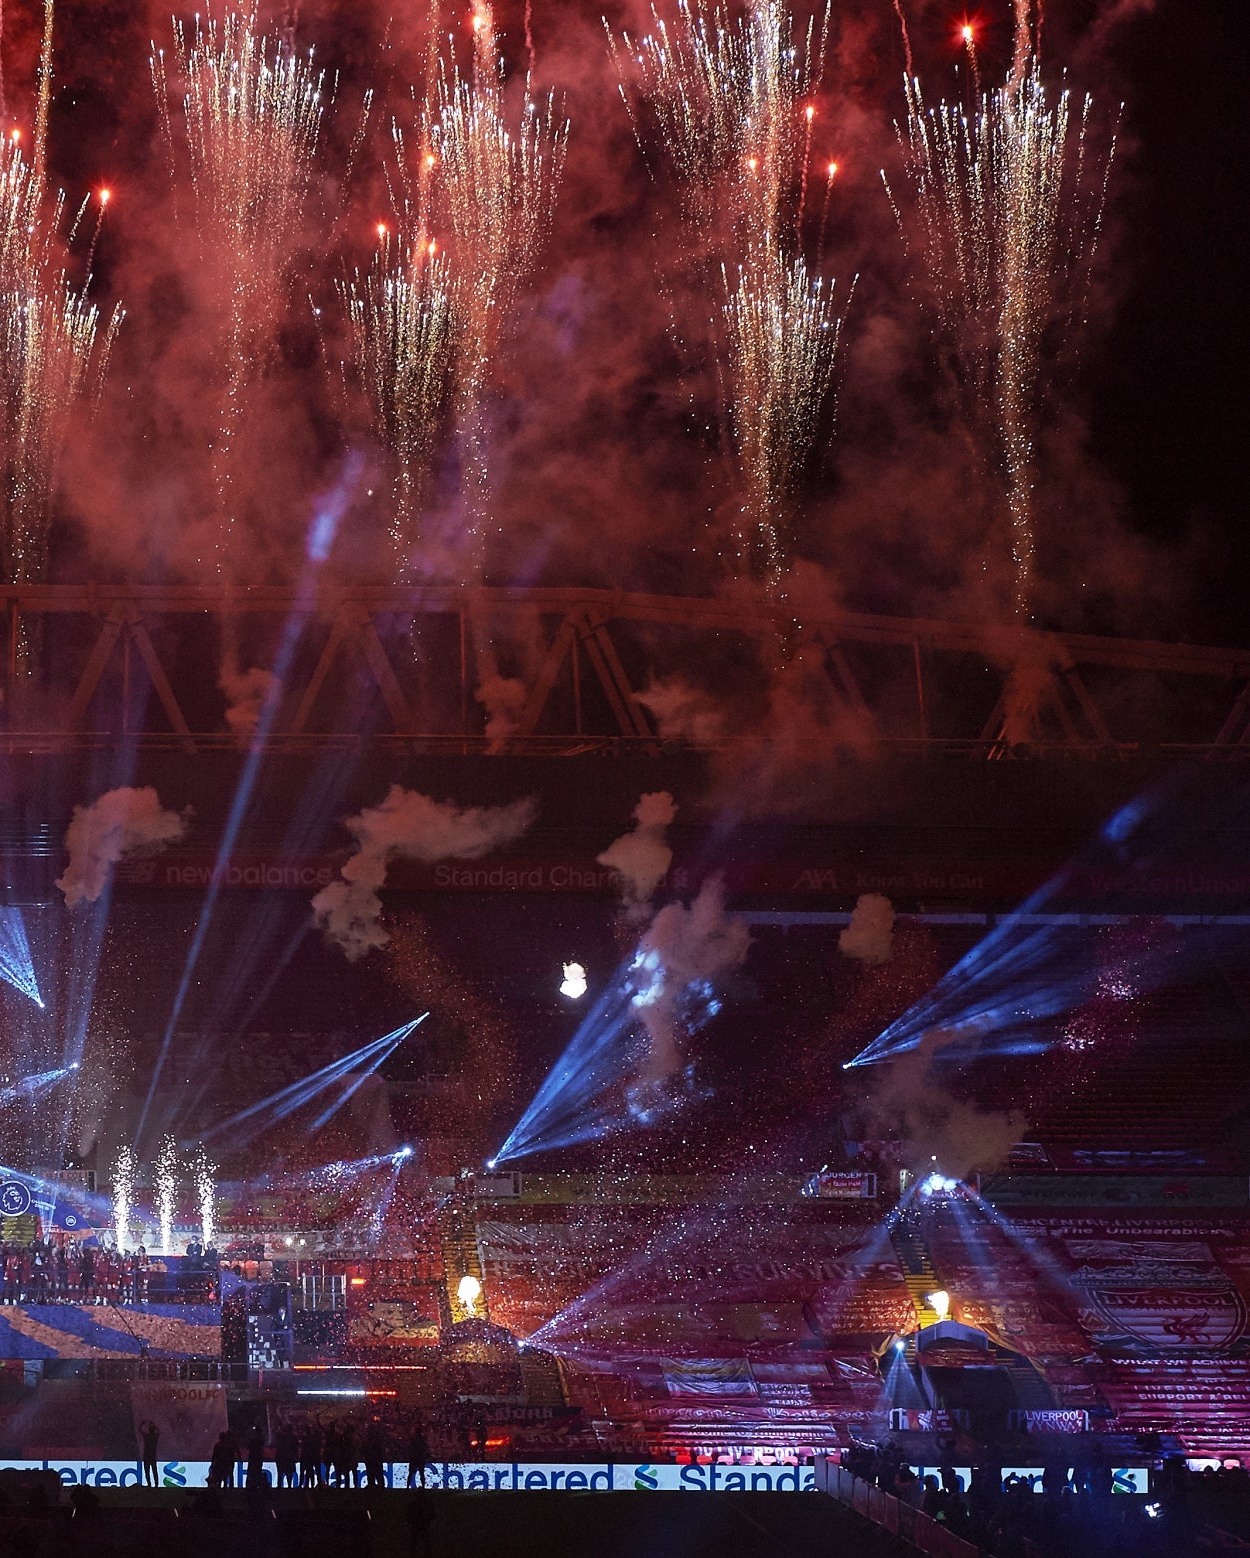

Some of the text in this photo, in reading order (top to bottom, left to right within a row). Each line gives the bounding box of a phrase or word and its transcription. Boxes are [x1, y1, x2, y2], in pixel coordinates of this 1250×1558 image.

[167, 863, 333, 885] new balance
[435, 865, 543, 887] Standard
[792, 869, 838, 891] AXA
[1102, 1295, 1235, 1306] LIVERPOOL
[1025, 1410, 1083, 1422] LIVERPOOL
